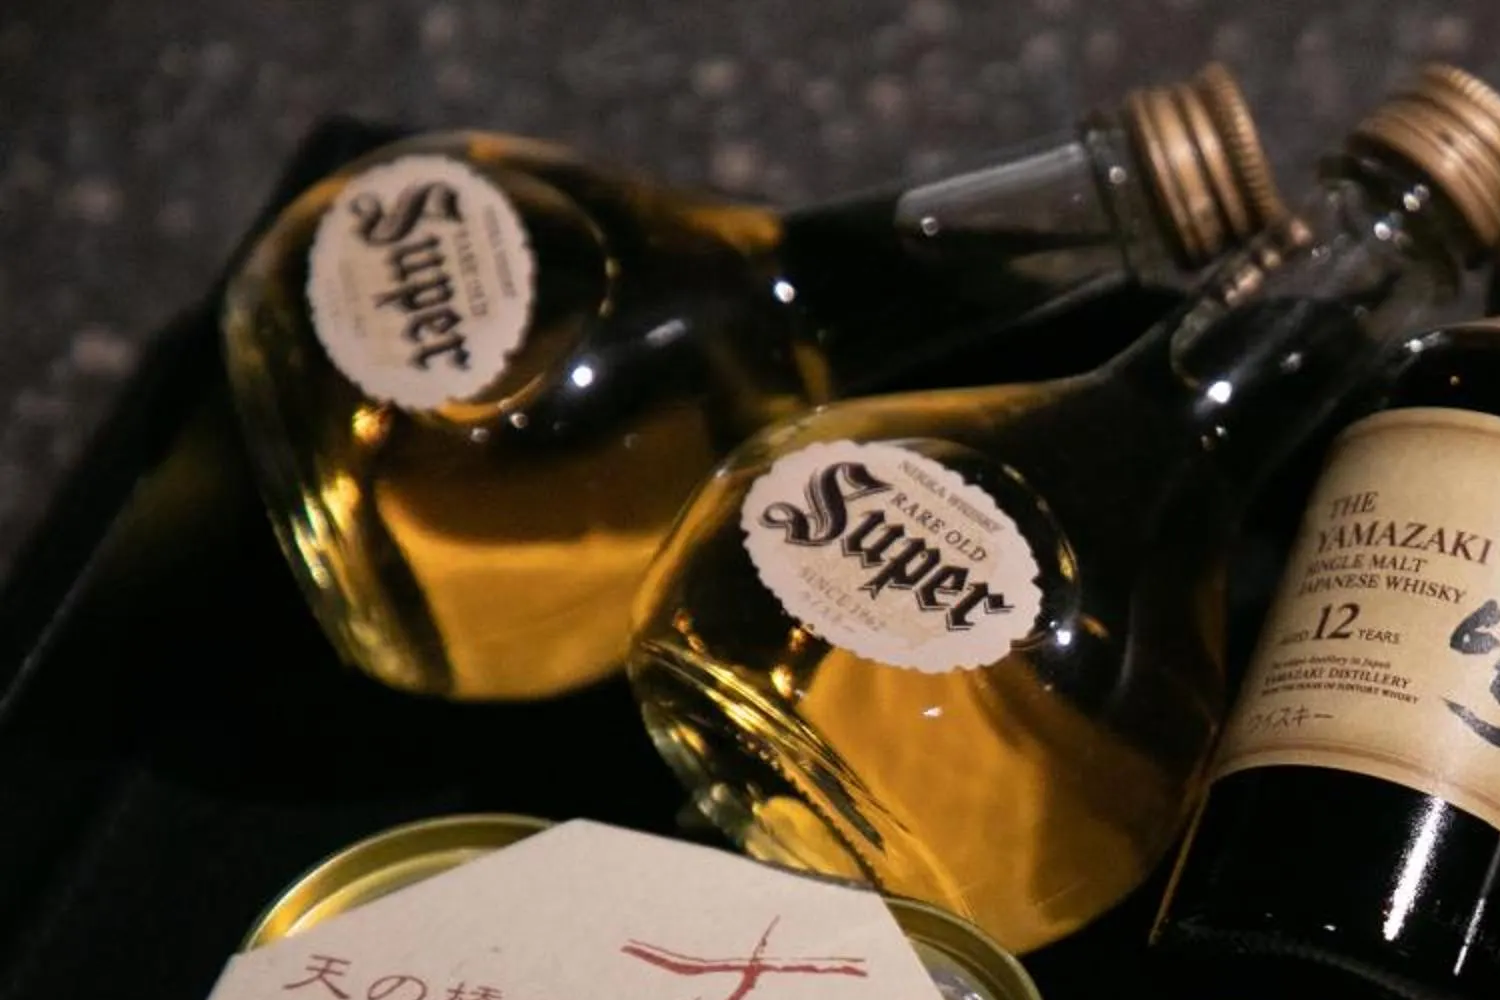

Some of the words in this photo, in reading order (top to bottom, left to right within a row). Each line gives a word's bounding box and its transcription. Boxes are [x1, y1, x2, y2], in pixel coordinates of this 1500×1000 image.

[348, 181, 471, 371] Super
[890, 492, 946, 535] RARE
[945, 529, 987, 562] OLD
[1328, 491, 1379, 519] THE
[757, 461, 1015, 632] Super
[1306, 553, 1365, 577] SINGLE
[1371, 553, 1429, 574] MALT
[1317, 520, 1494, 566] YAMAZAKI
[1298, 573, 1381, 597] JAPANESE
[1385, 574, 1467, 604] WHISKY
[1311, 602, 1361, 641] 12
[1356, 628, 1400, 646] YEARS
[1328, 668, 1413, 690] DISTILLERY
